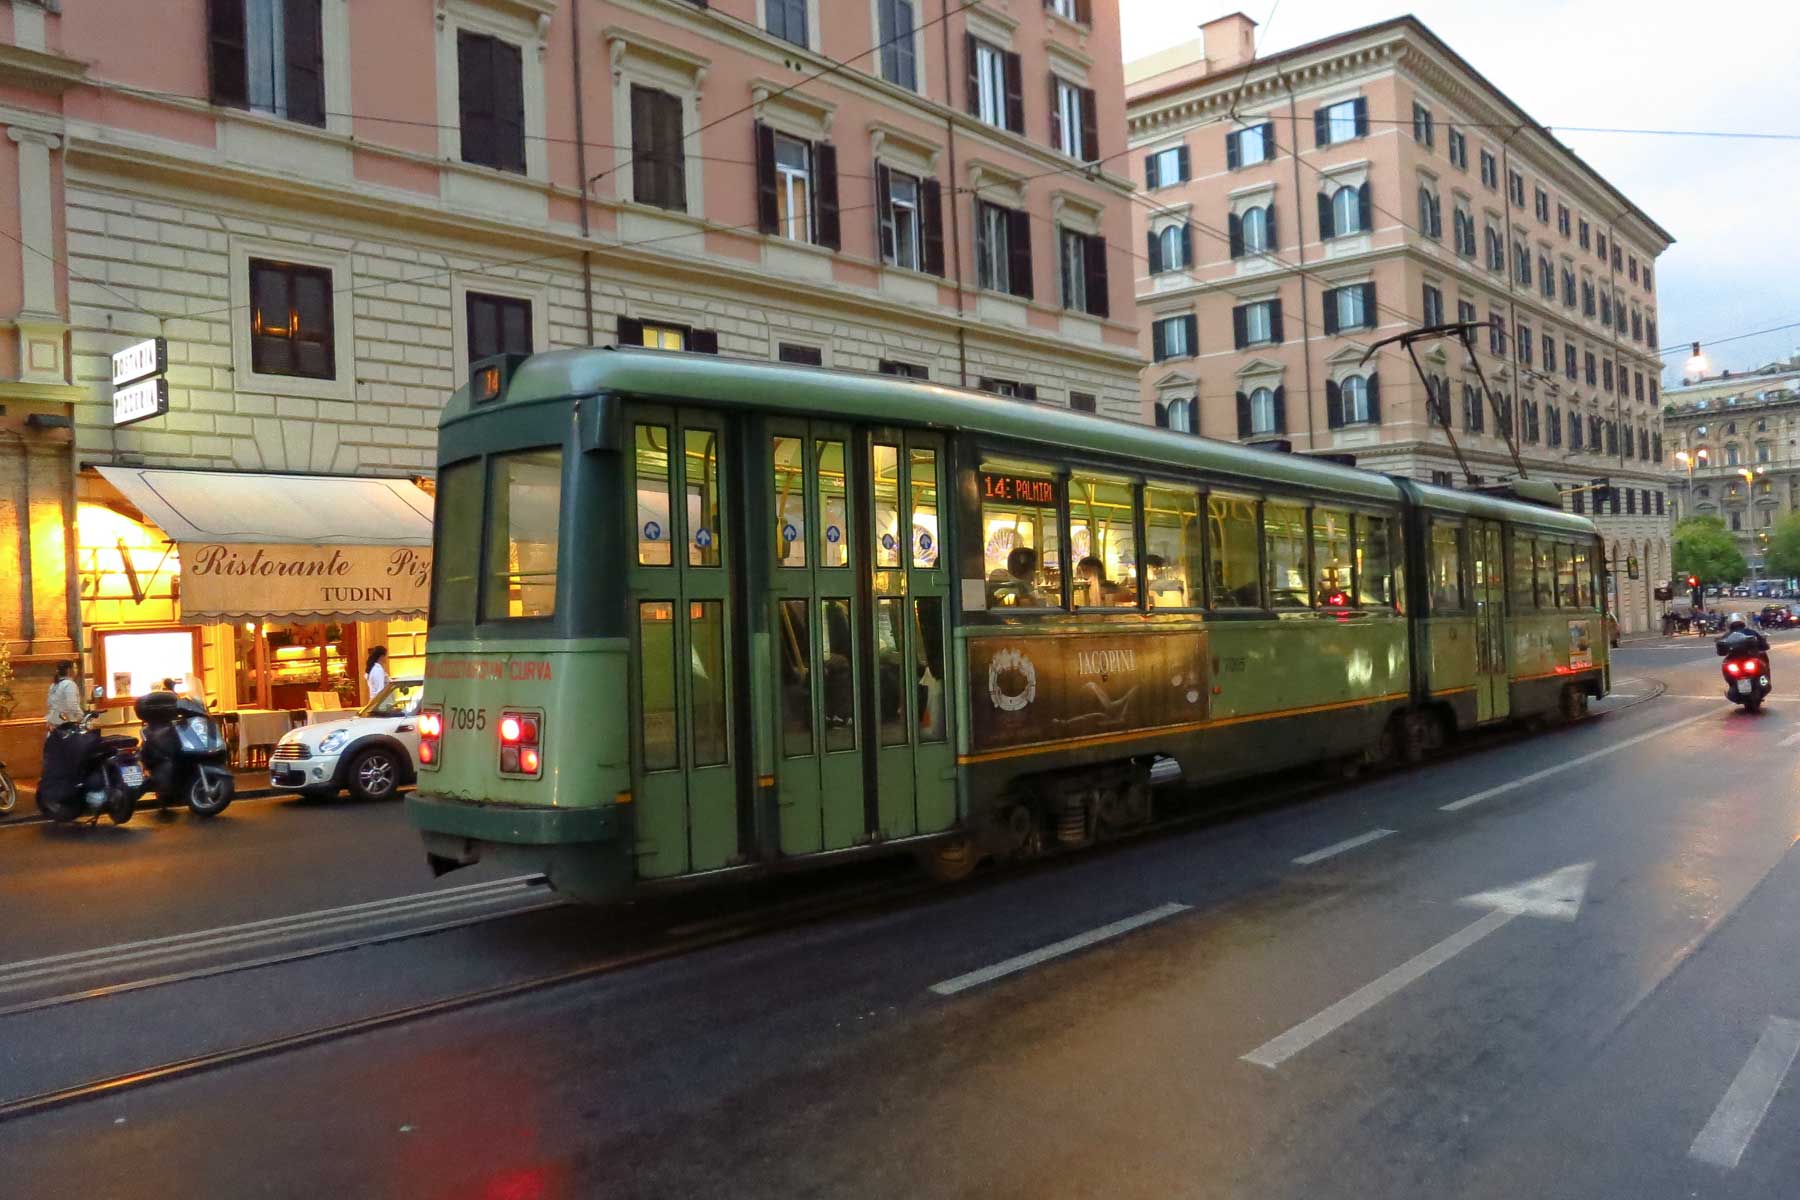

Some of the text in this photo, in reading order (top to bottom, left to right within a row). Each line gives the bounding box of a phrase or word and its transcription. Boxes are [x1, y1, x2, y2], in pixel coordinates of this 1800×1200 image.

[114, 387, 156, 417] PIZZERIA
[192, 544, 351, 576] Ristorante
[320, 586, 392, 602] TUDINI
[510, 660, 553, 681] CURVA
[1078, 649, 1137, 675] IACOPINI
[450, 706, 486, 731] 7095
